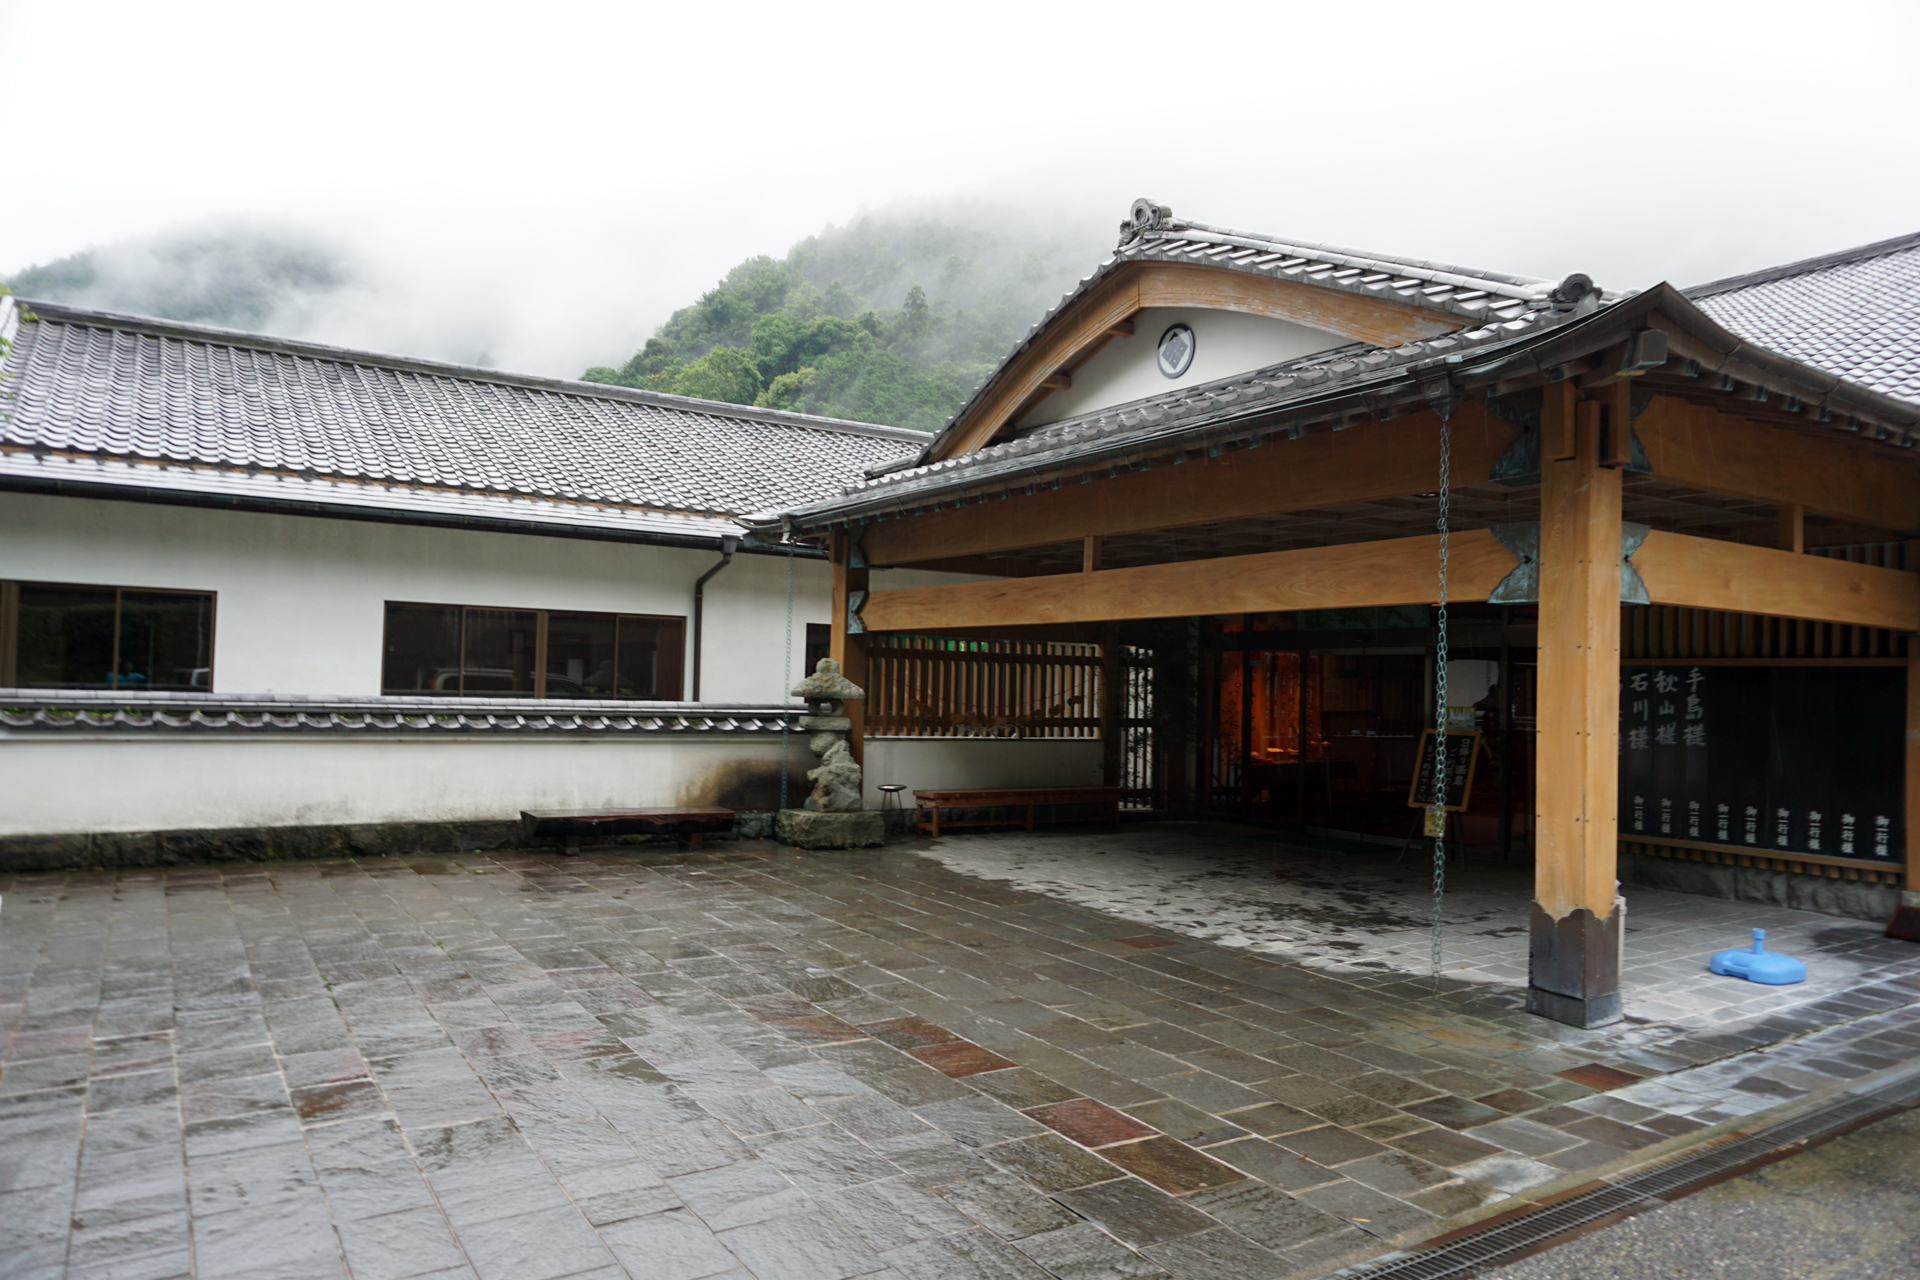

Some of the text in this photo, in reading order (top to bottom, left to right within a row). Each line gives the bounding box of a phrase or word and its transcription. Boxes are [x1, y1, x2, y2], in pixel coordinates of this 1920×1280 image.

[1628, 672, 1650, 750] 石川様
[1653, 669, 1679, 745] 秋山様
[1682, 666, 1706, 747] 手島様
